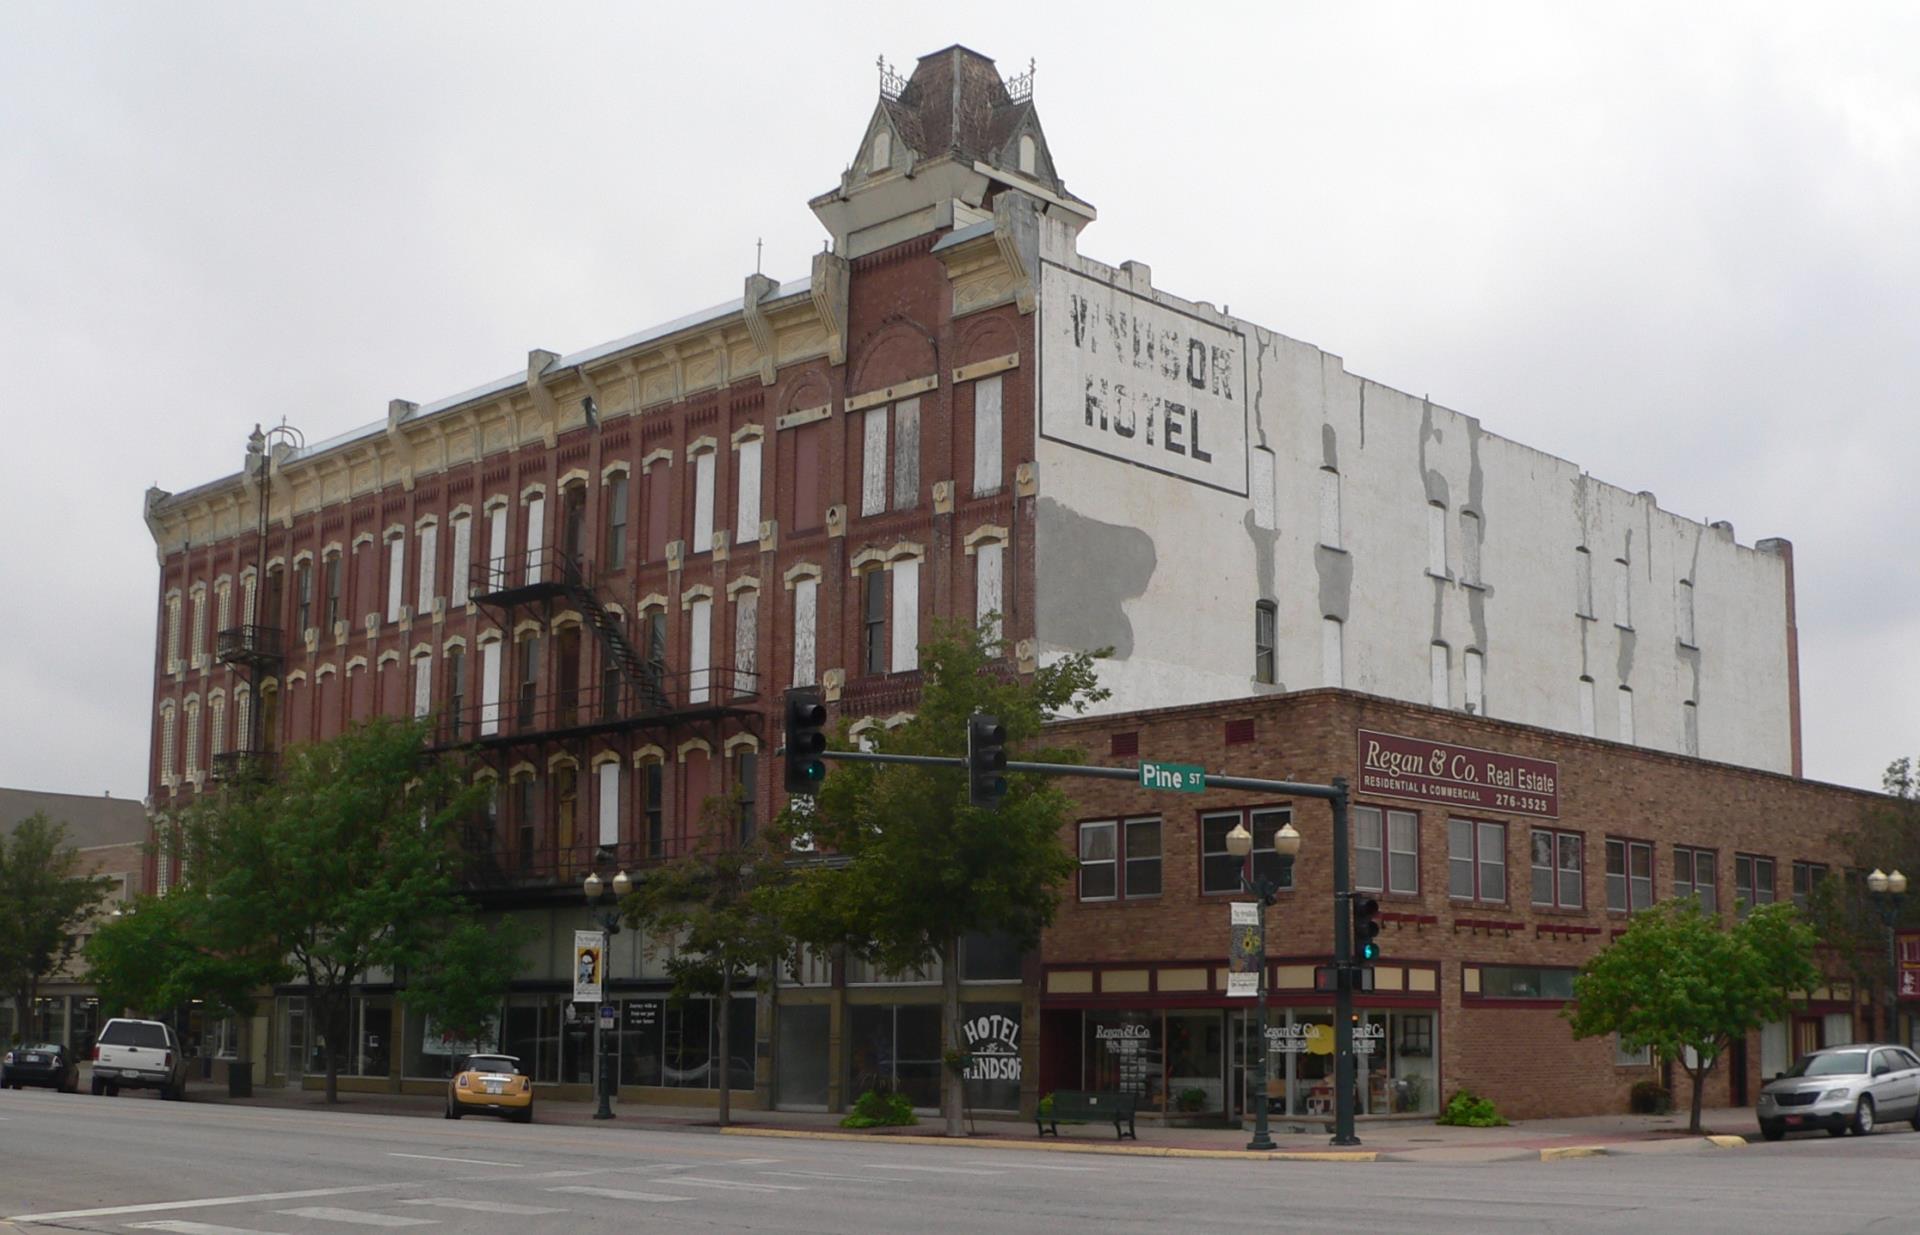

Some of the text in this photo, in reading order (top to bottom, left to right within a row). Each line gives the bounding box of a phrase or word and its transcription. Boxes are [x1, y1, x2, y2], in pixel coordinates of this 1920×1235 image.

[1085, 372, 1212, 464] HOTEL
[1143, 764, 1201, 788] Pine ST
[1366, 740, 1554, 793] Regan & Co. Real Estate
[1364, 775, 1547, 812] RESIDENTIAL & COMMERCIAL 276-3525
[963, 1014, 1019, 1050] HOTEL
